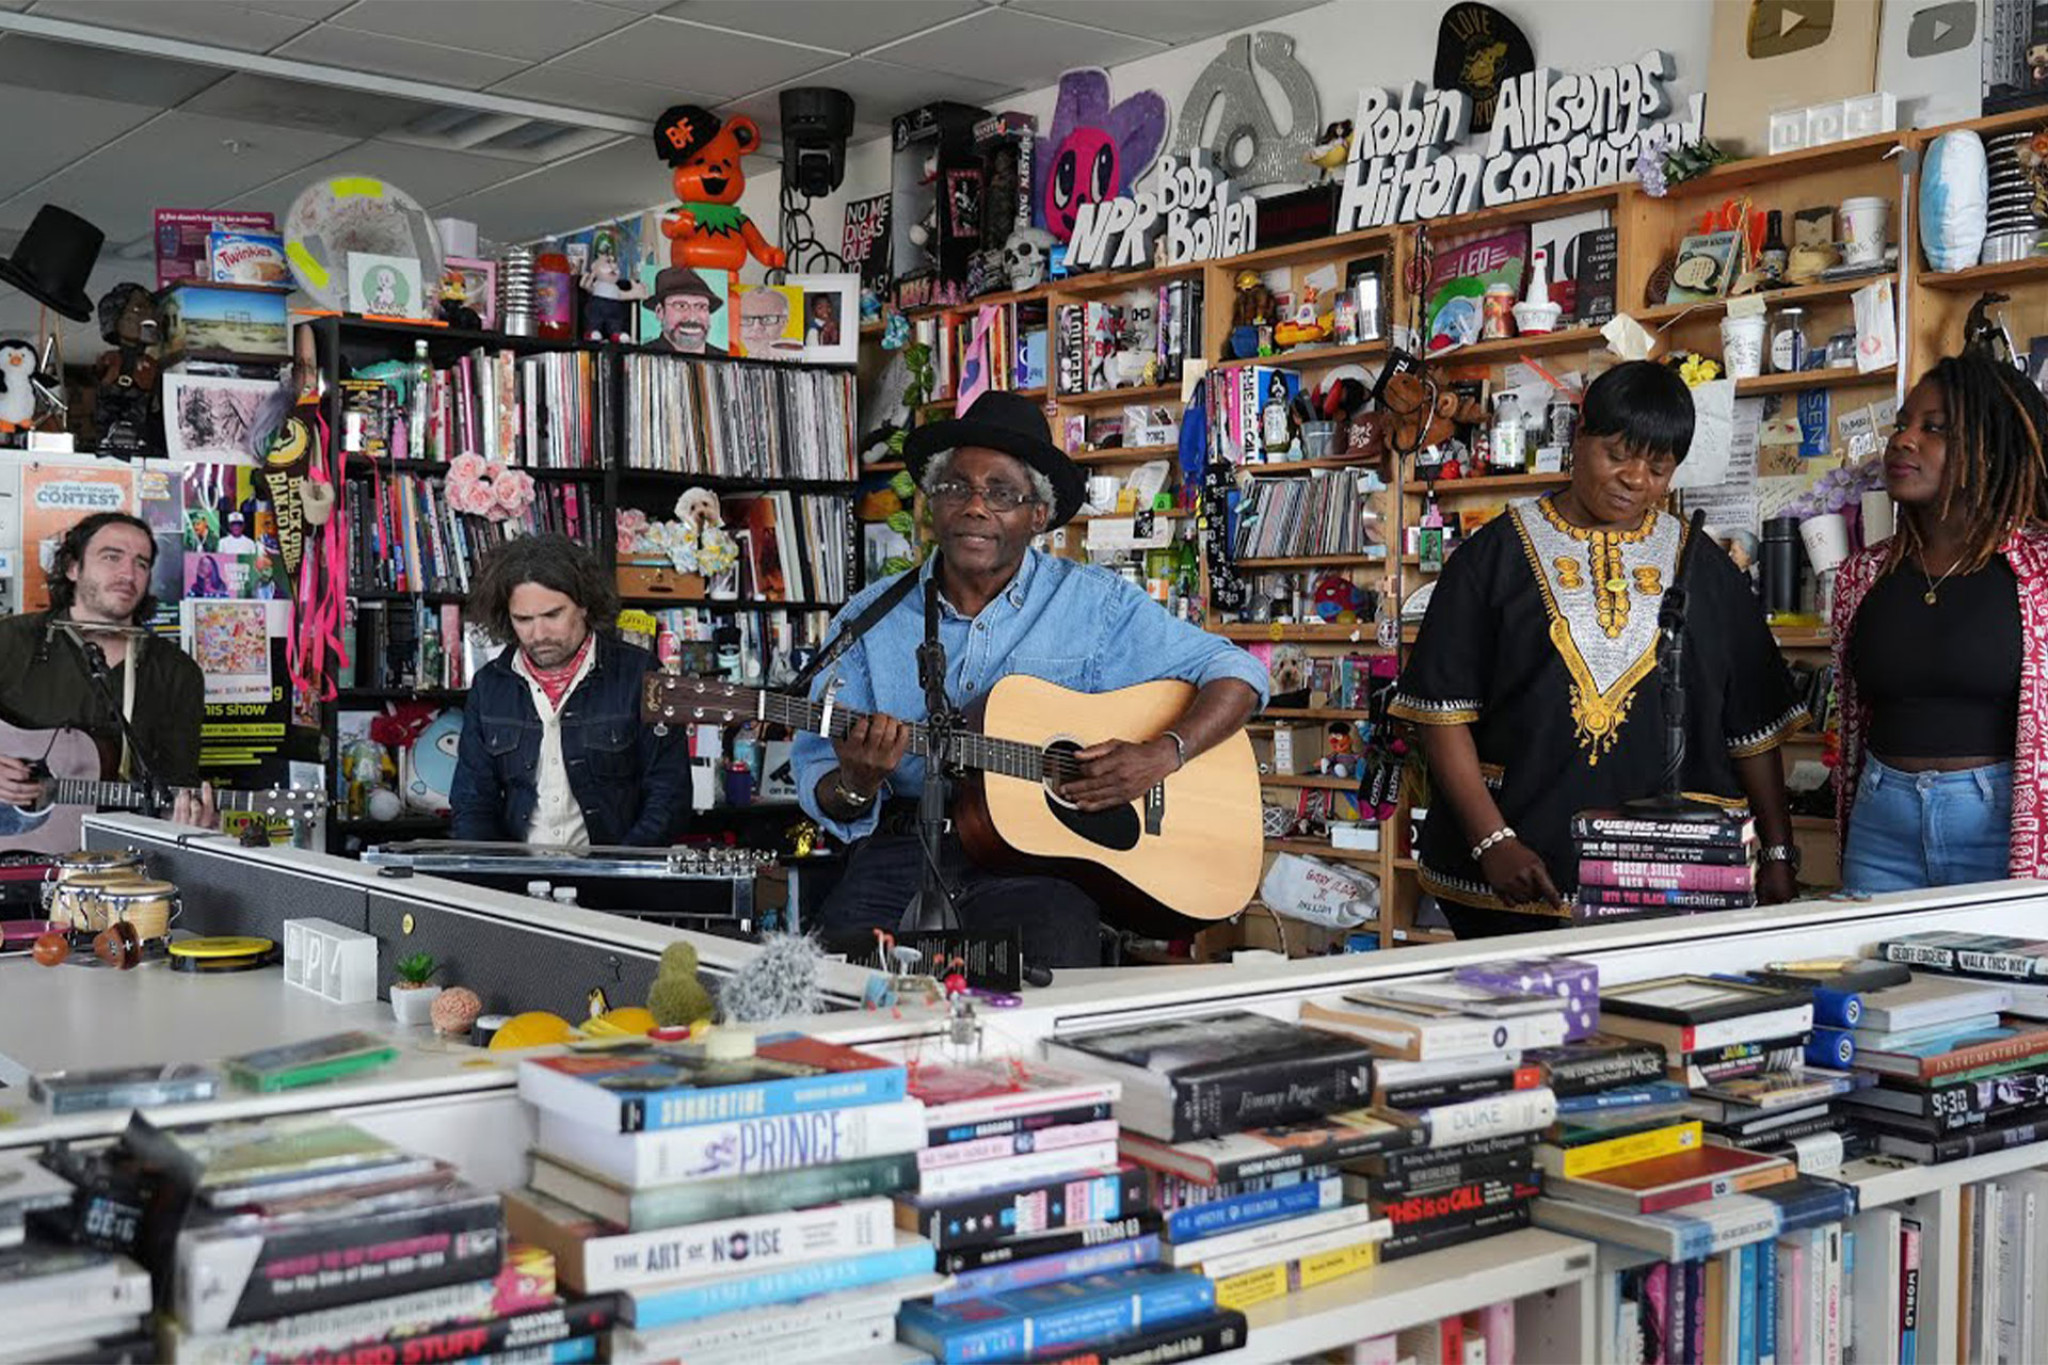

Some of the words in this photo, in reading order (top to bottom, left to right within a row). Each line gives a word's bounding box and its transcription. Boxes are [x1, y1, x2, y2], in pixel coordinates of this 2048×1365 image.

[1450, 11, 1491, 40] LOVE
[1350, 82, 1463, 161] Robin
[1157, 148, 1214, 213] Bob
[1337, 148, 1482, 234] Hilton
[847, 202, 868, 223] NO
[869, 196, 890, 217] ME
[1168, 180, 1257, 265] Boilen
[844, 224, 884, 244] DIGAS
[1062, 193, 1157, 269] NPR
[219, 246, 273, 268] Twinkies
[843, 241, 871, 262] QUE
[37, 491, 120, 506] CONTEST
[769, 787, 782, 796] on
[1592, 819, 1657, 831] QUEENS
[1670, 823, 1721, 835] NOISE
[1612, 861, 1650, 877] CROSBY,
[1650, 862, 1685, 878] STILLS,
[1891, 945, 1916, 961] GEOFF
[1916, 948, 1949, 964] EDGERS
[1962, 952, 1986, 968] WALK
[1987, 954, 2007, 971] THIS
[2008, 957, 2028, 974] WAY
[1936, 1041, 2033, 1073] INSTRUMENTHEAD
[1453, 1104, 1500, 1131] DUKE
[1932, 1088, 1968, 1118] 9:30
[741, 1110, 842, 1173] PRINCE
[1386, 1198, 1423, 1224] THIS
[1451, 1185, 1484, 1211] CALL
[614, 1254, 640, 1271] THE
[647, 1242, 683, 1272] ART
[686, 1243, 704, 1259] OF
[711, 1227, 782, 1263] NOISE
[1904, 1271, 1918, 1328] WORLD
